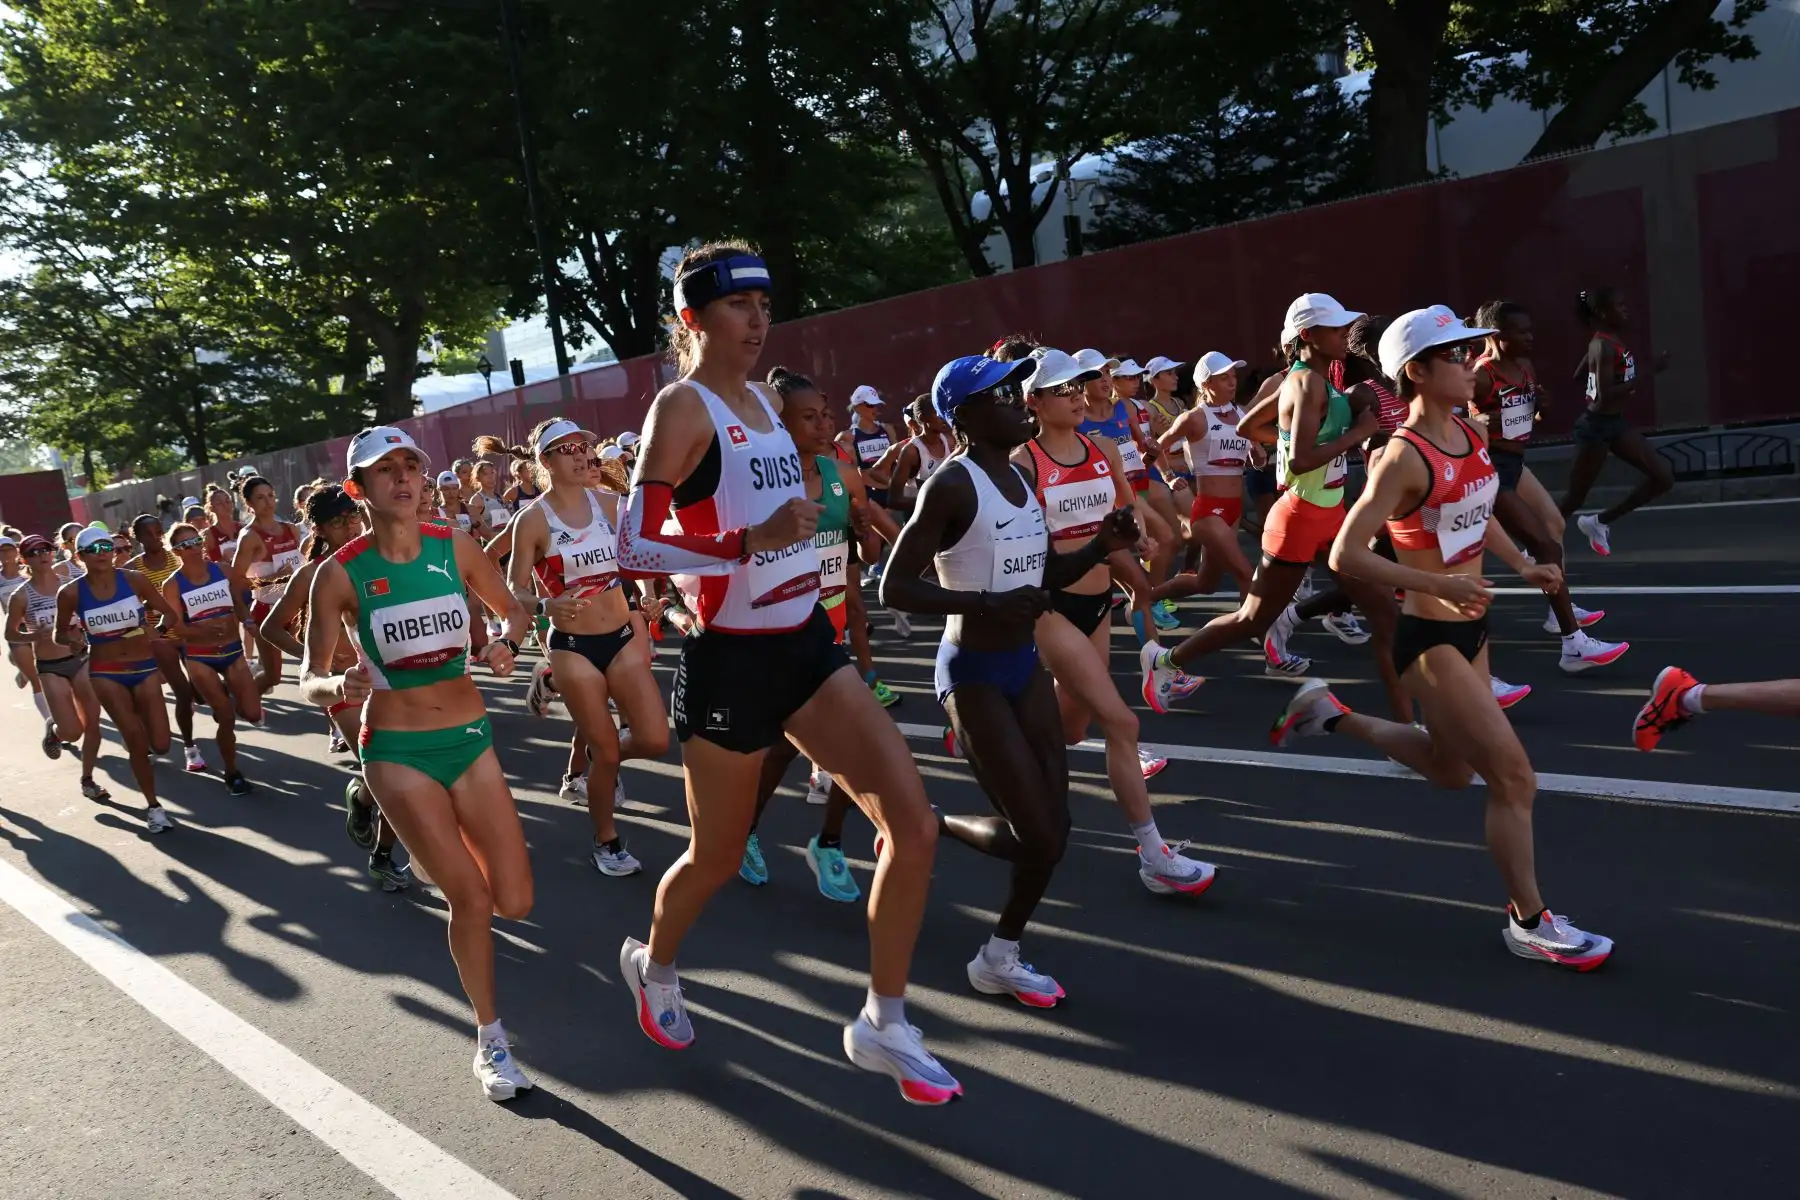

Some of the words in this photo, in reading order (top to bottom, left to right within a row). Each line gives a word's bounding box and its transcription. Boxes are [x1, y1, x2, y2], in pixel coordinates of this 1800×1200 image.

[1219, 439, 1247, 451] MACH
[749, 453, 802, 490] SUISS
[1059, 491, 1109, 513] ICHIYAMA
[571, 545, 616, 569] TWELL
[187, 588, 229, 608] CHACHA
[87, 609, 136, 628] BONILLA
[383, 608, 464, 645] RIBEIRO
